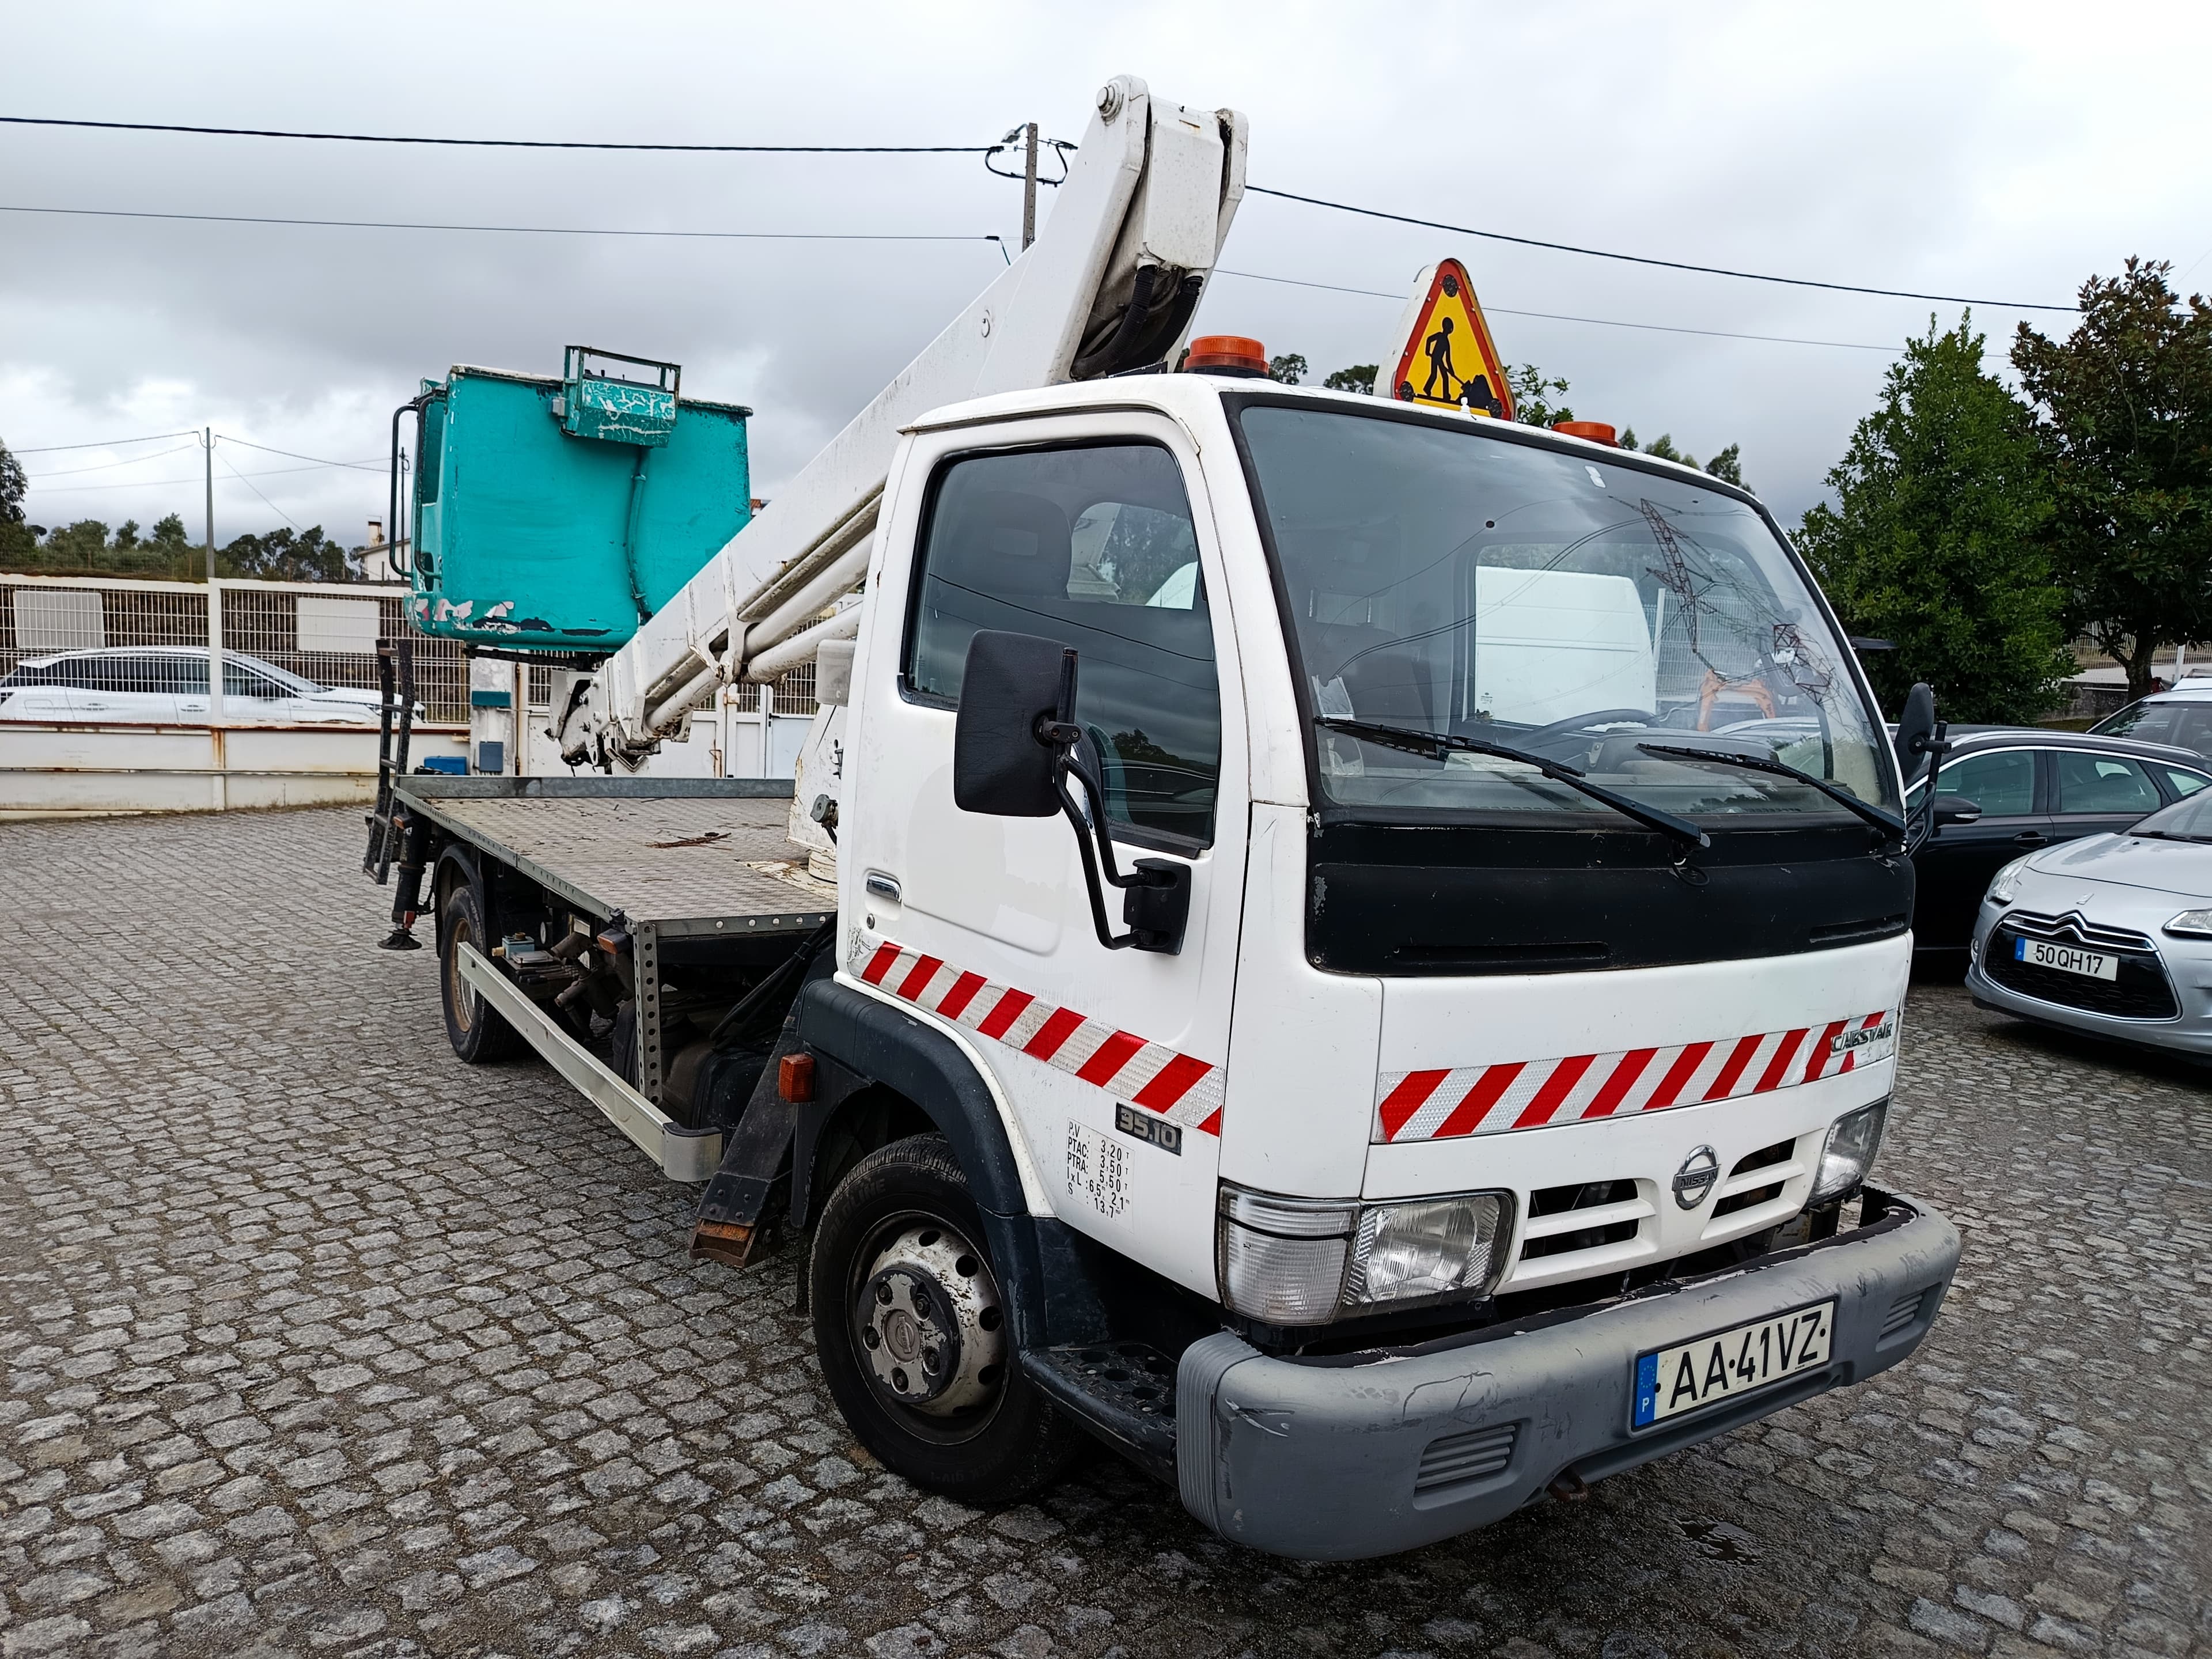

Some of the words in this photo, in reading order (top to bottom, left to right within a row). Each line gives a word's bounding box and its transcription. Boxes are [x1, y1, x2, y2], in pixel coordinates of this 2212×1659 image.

[1831, 1022, 1893, 1052] CABSTAR
[1119, 1107, 1177, 1149] 35.10
[1101, 1139, 1122, 1161] 3,20
[1100, 1155, 1122, 1177] 3,50
[1068, 1182, 1073, 1195] S
[1100, 1170, 1121, 1192] 5,50
[1680, 1170, 1717, 1188] NISSAN
[1642, 1397, 1649, 1412] P
